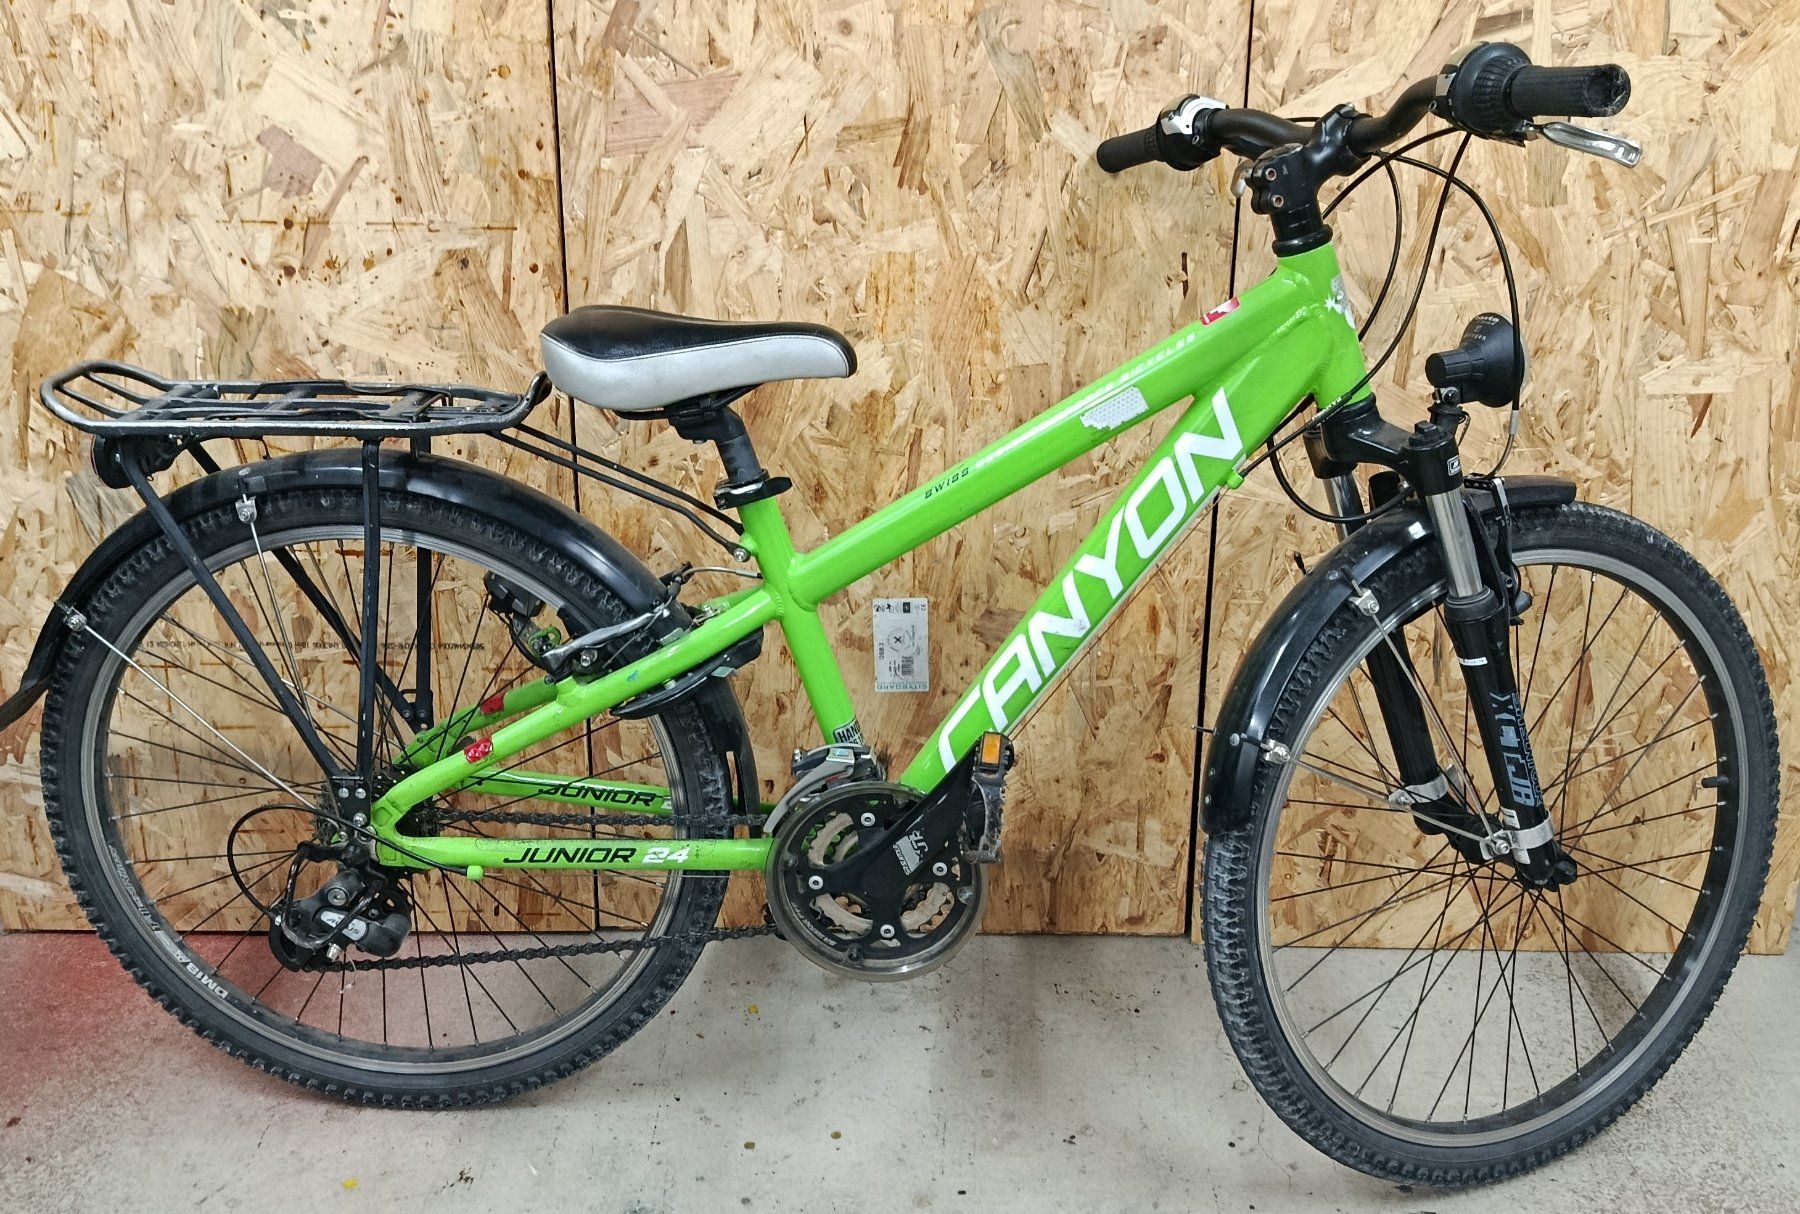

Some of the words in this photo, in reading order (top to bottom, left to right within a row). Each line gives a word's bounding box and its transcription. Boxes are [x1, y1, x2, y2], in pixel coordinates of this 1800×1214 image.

[925, 467, 969, 499] SWISS
[938, 387, 1243, 774] CANYON
[538, 784, 658, 806] JUNIOR
[503, 847, 637, 863] JUNIOR
[642, 847, 691, 864] 24
